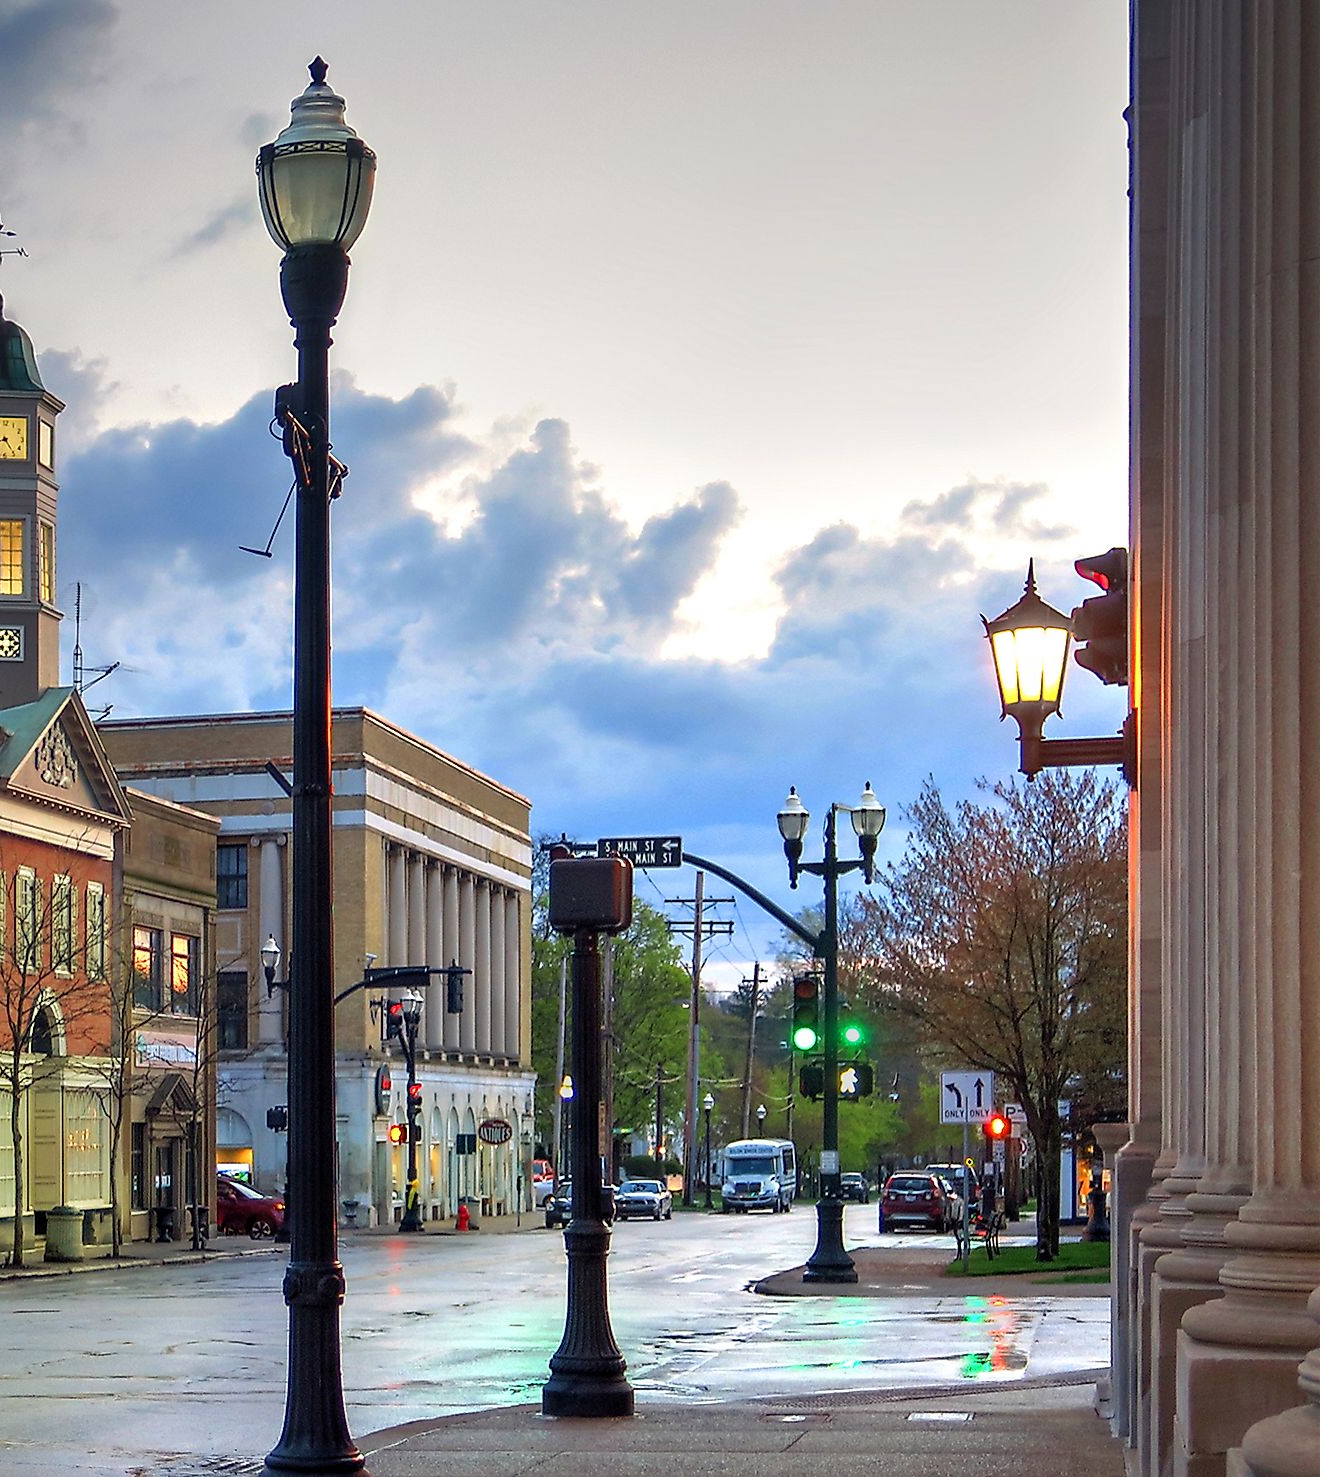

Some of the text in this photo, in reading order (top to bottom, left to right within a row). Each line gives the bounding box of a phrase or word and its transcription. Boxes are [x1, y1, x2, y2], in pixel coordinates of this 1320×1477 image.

[605, 841, 655, 852] S MAIN ST
[635, 853, 656, 864] MAIN
[662, 852, 672, 864] ST
[944, 1110, 964, 1118] ONLY
[969, 1109, 990, 1118] ONLY
[480, 1126, 511, 1143] ANTIQUES
